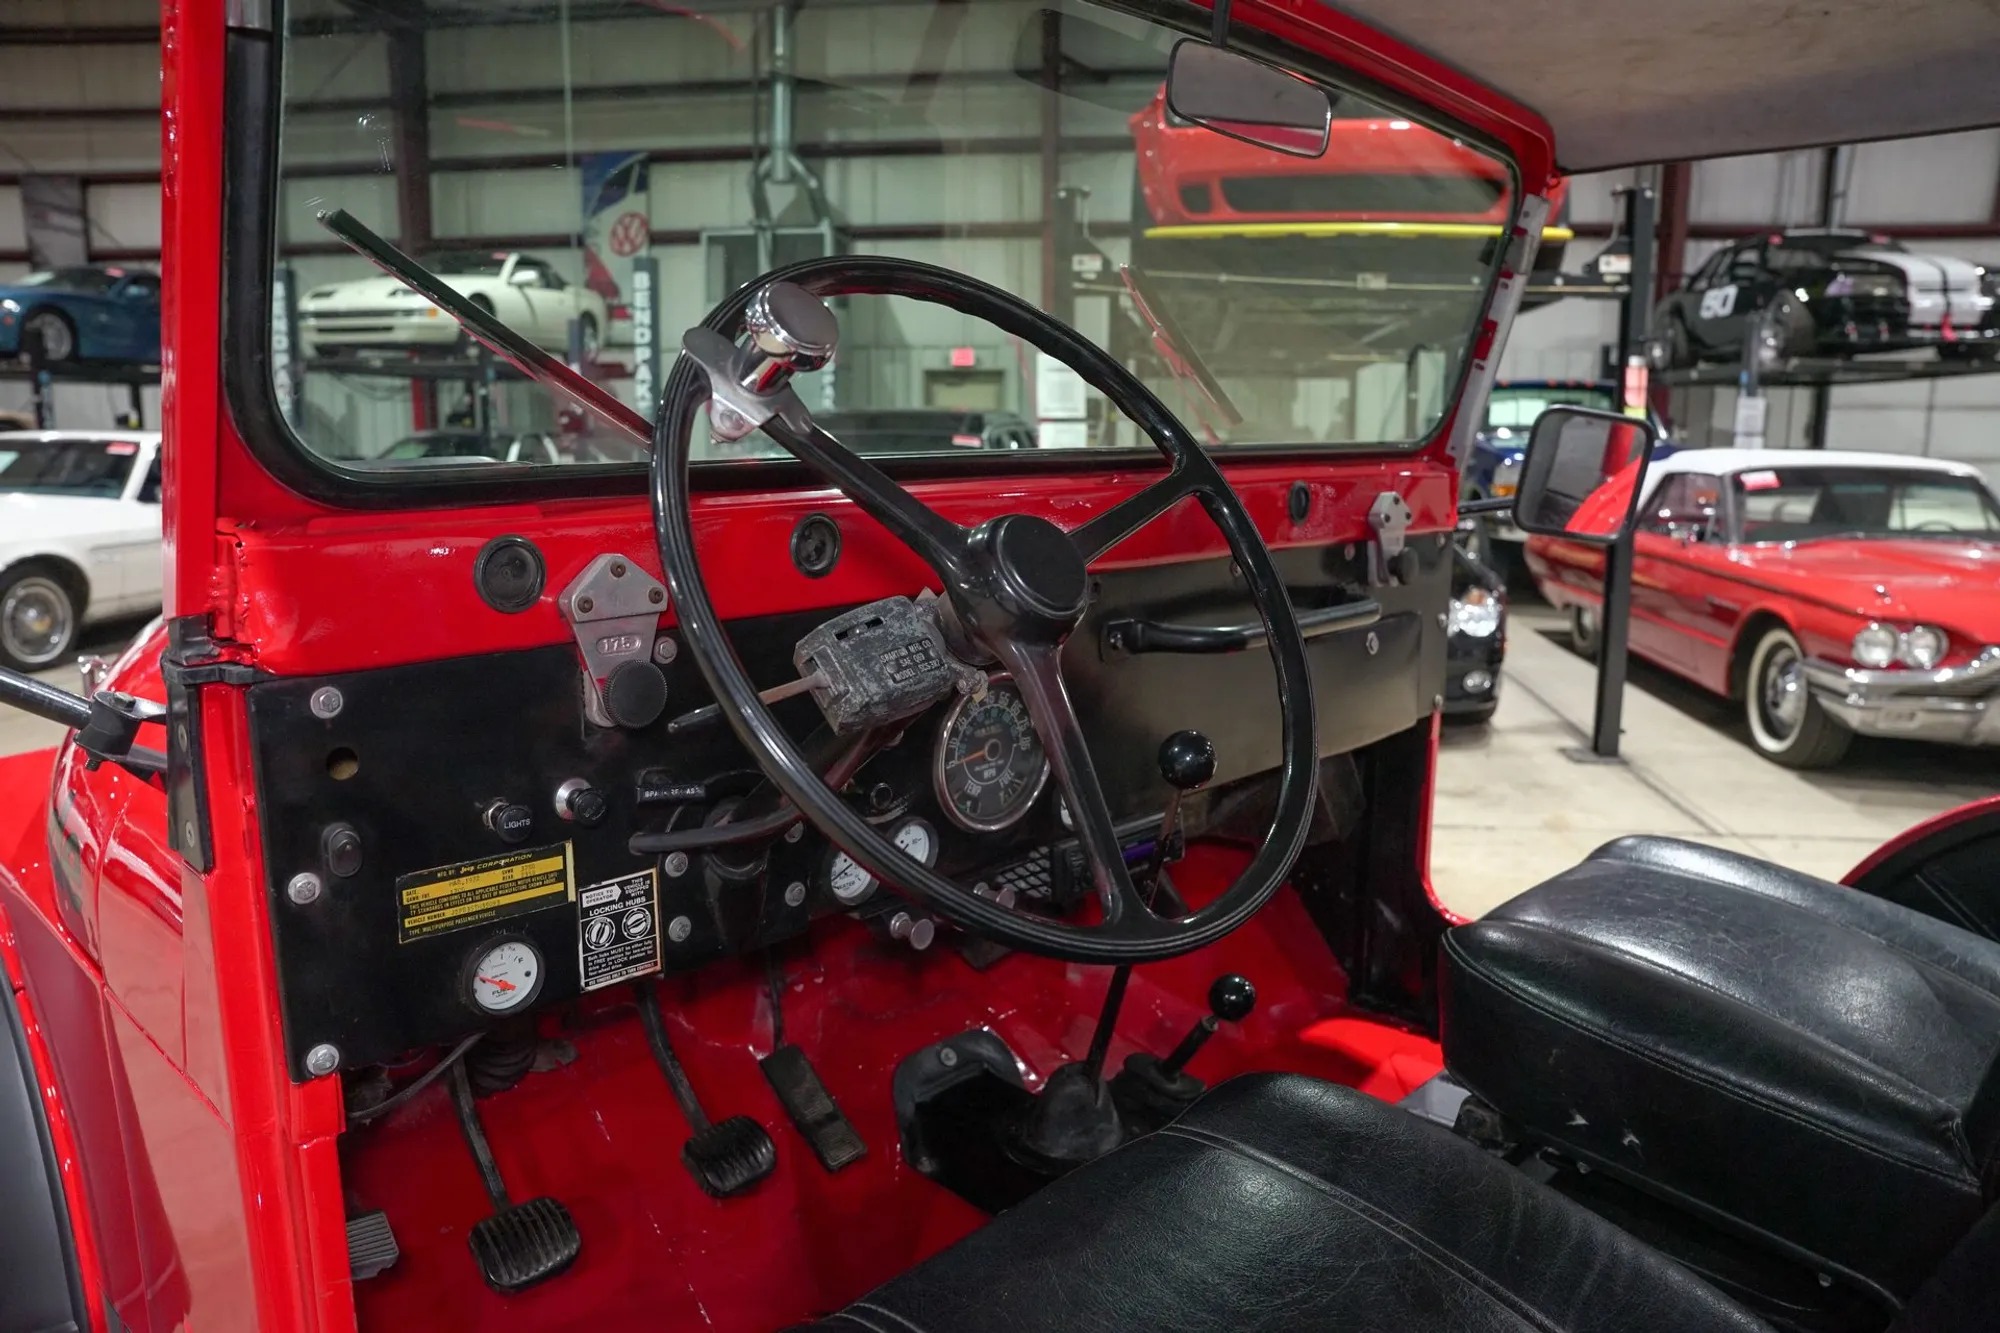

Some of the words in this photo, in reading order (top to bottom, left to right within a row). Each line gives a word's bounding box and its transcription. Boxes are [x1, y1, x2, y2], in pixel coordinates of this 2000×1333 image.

[893, 668, 915, 681] MODEL
[998, 768, 1016, 789] FUEL
[964, 780, 982, 797] TEMP
[504, 818, 531, 829] LIGHTS
[459, 864, 474, 874] Jeep
[476, 852, 532, 869] CORPORATION
[623, 881, 643, 891] VEHICLE
[625, 884, 649, 894] EQUIPPED
[409, 902, 419, 910] THIS
[420, 898, 437, 908] VEHICLE
[438, 893, 460, 903] CONFORMS
[475, 884, 498, 895] APPLICABLE
[499, 880, 516, 889] FEDERAL
[416, 903, 443, 914] STANDARDS
[450, 898, 465, 906] EFFECT
[498, 884, 527, 895] MANUFACTURE
[585, 891, 603, 899] NOTICE
[586, 893, 612, 904] OPERATOR
[589, 901, 623, 916] LOCKING
[625, 896, 645, 907] HUBS
[407, 916, 425, 925] VEHICLE
[427, 912, 445, 920] NUMBER
[422, 920, 454, 932] MULTIPURPOSE
[455, 914, 478, 924] PASSENGER
[479, 910, 495, 918] VEHICLE
[610, 946, 624, 954] MUST
[631, 941, 643, 949] either
[593, 957, 606, 965] FREE
[606, 952, 623, 961] position
[614, 956, 628, 964] LOCK
[628, 951, 645, 960] position
